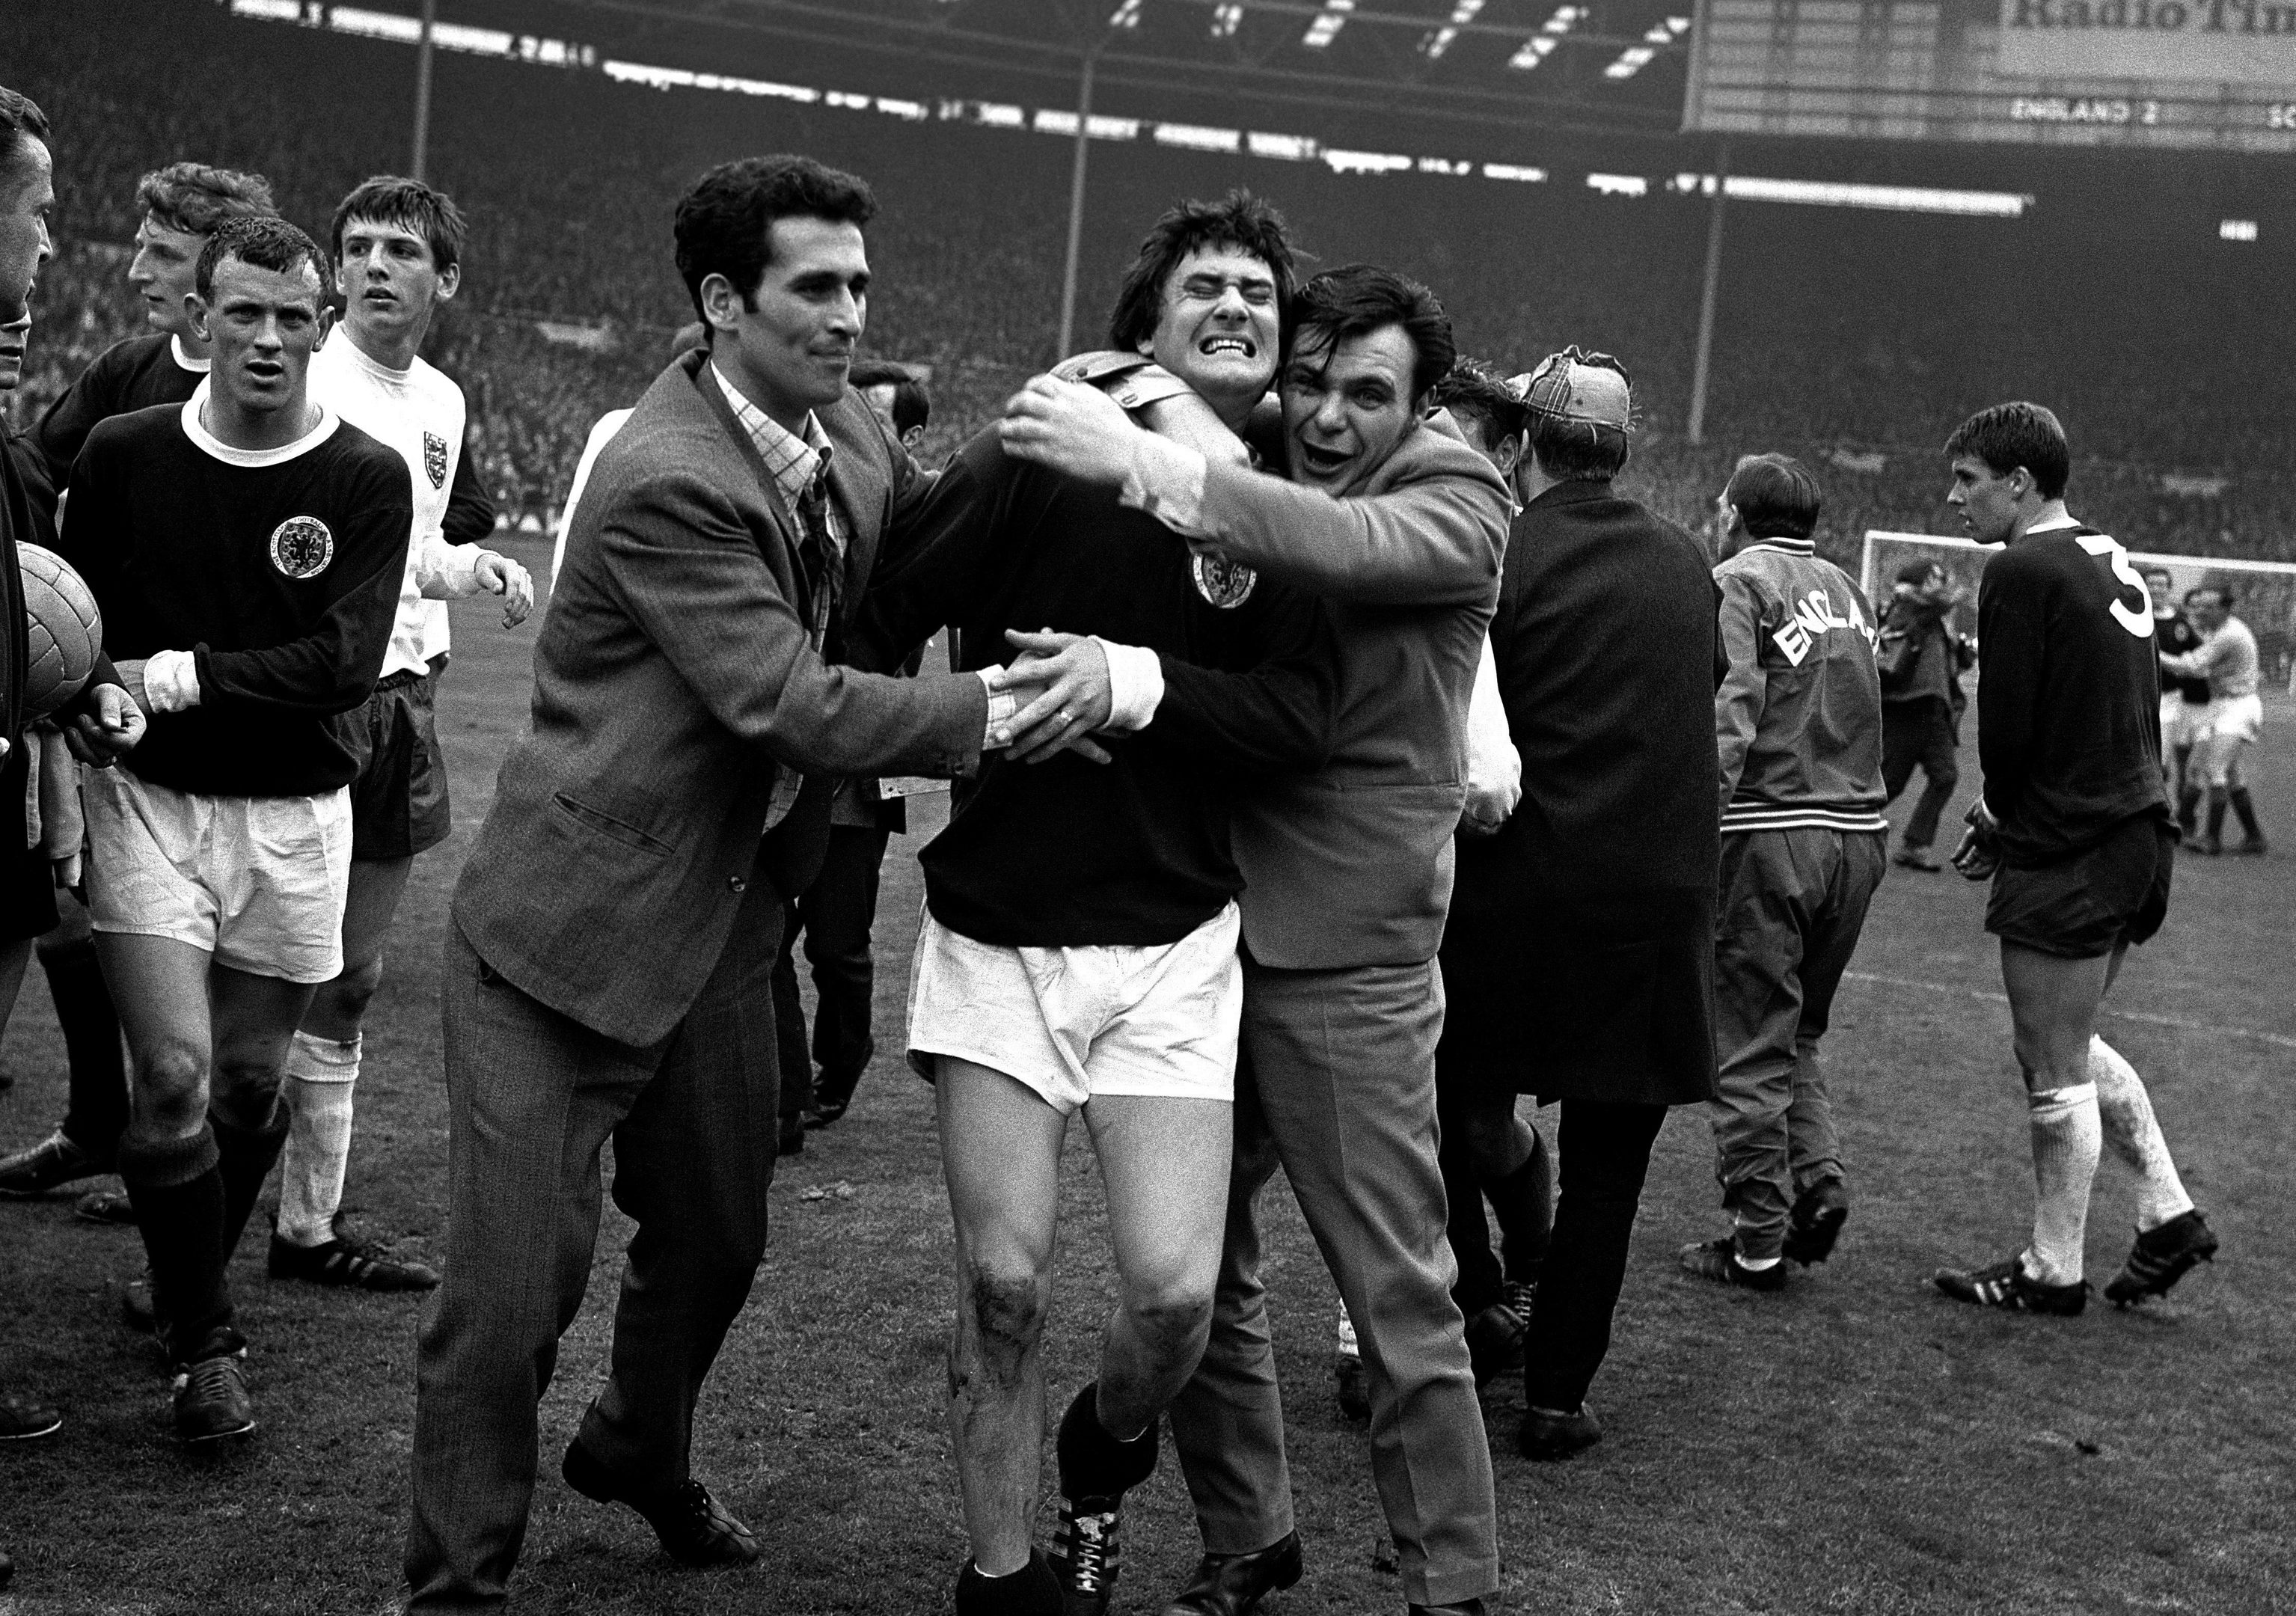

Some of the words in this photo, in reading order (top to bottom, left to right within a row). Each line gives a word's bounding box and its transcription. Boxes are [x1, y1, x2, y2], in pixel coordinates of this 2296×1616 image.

[2011, 0, 2187, 30] Radio
[2010, 98, 2131, 123] ENGLAND
[272, 525, 285, 554] SCOTTISH
[310, 539, 332, 575] ASSOCIATION
[2075, 535, 2154, 637] 3
